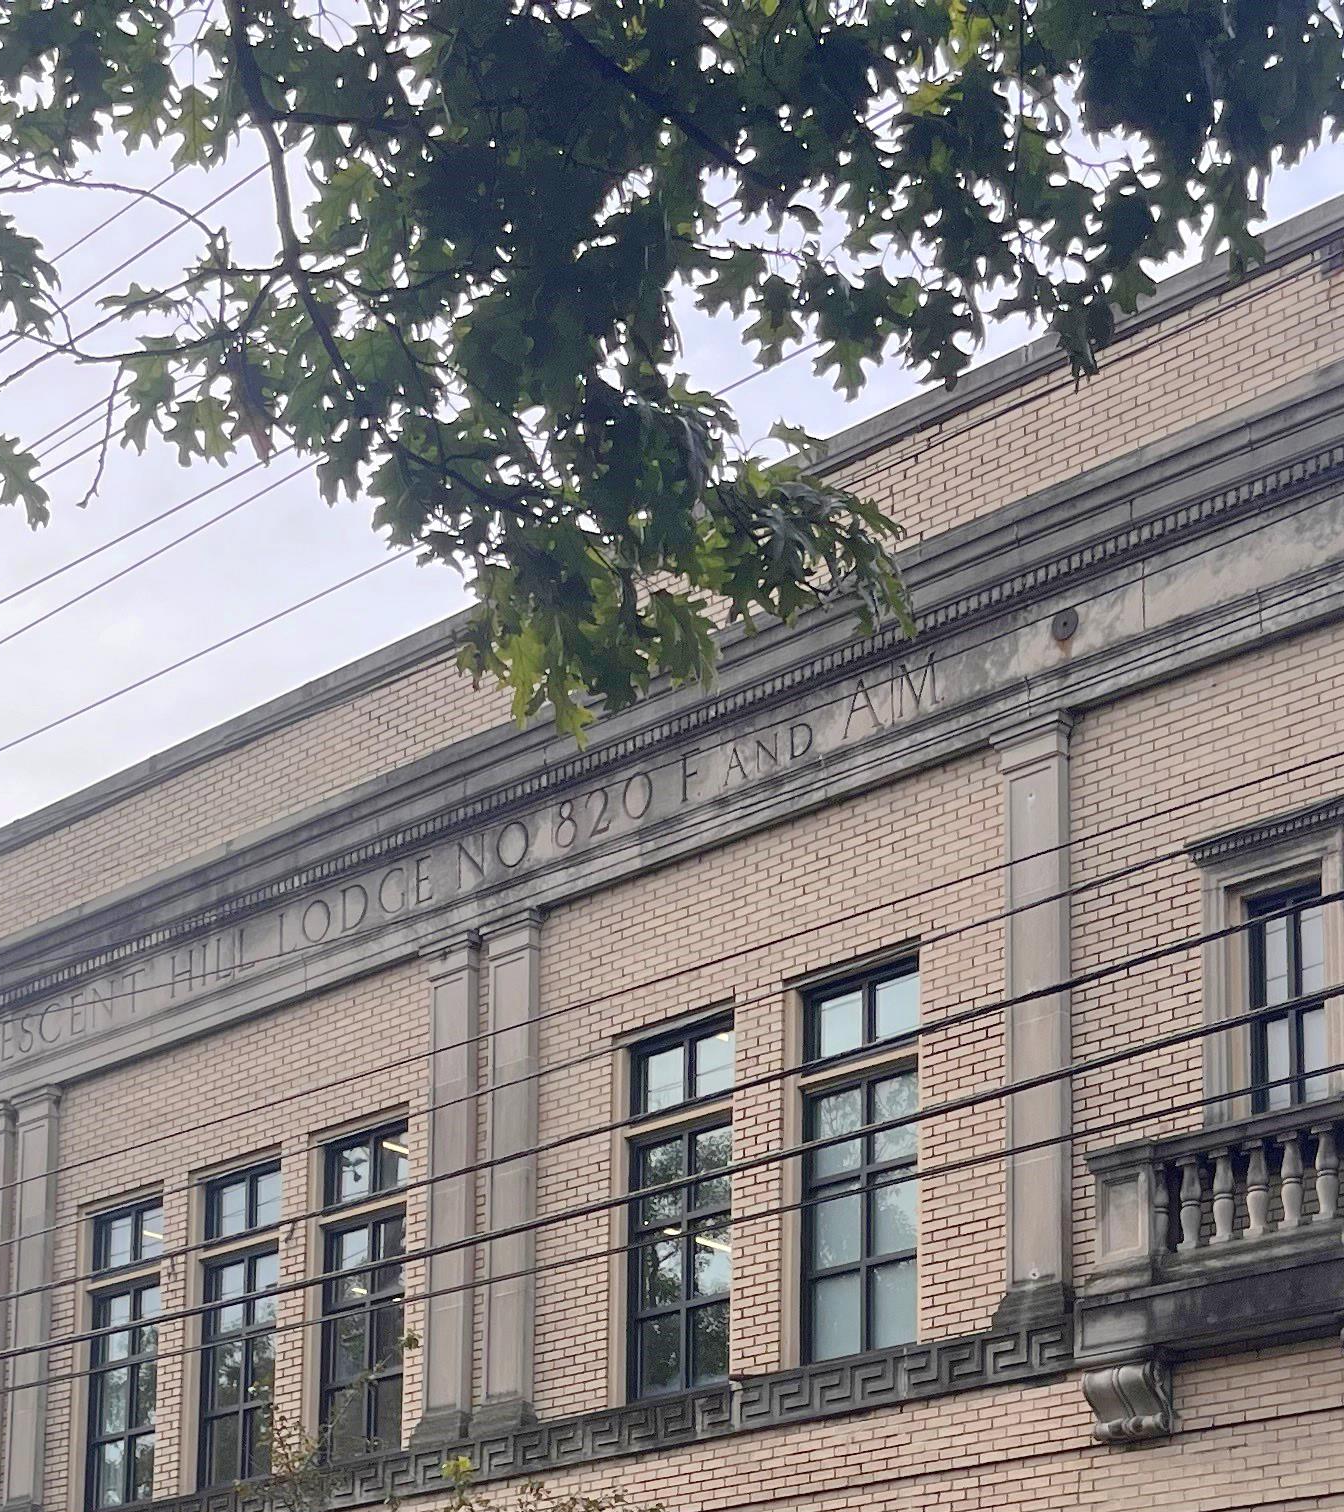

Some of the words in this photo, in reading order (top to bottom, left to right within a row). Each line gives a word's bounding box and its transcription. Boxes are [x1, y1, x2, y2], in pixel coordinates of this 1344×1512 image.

[169, 928, 255, 999] HILL
[278, 853, 434, 955] LODGE
[457, 820, 529, 890] NO
[555, 771, 653, 848] 820
[723, 722, 814, 788] AND
